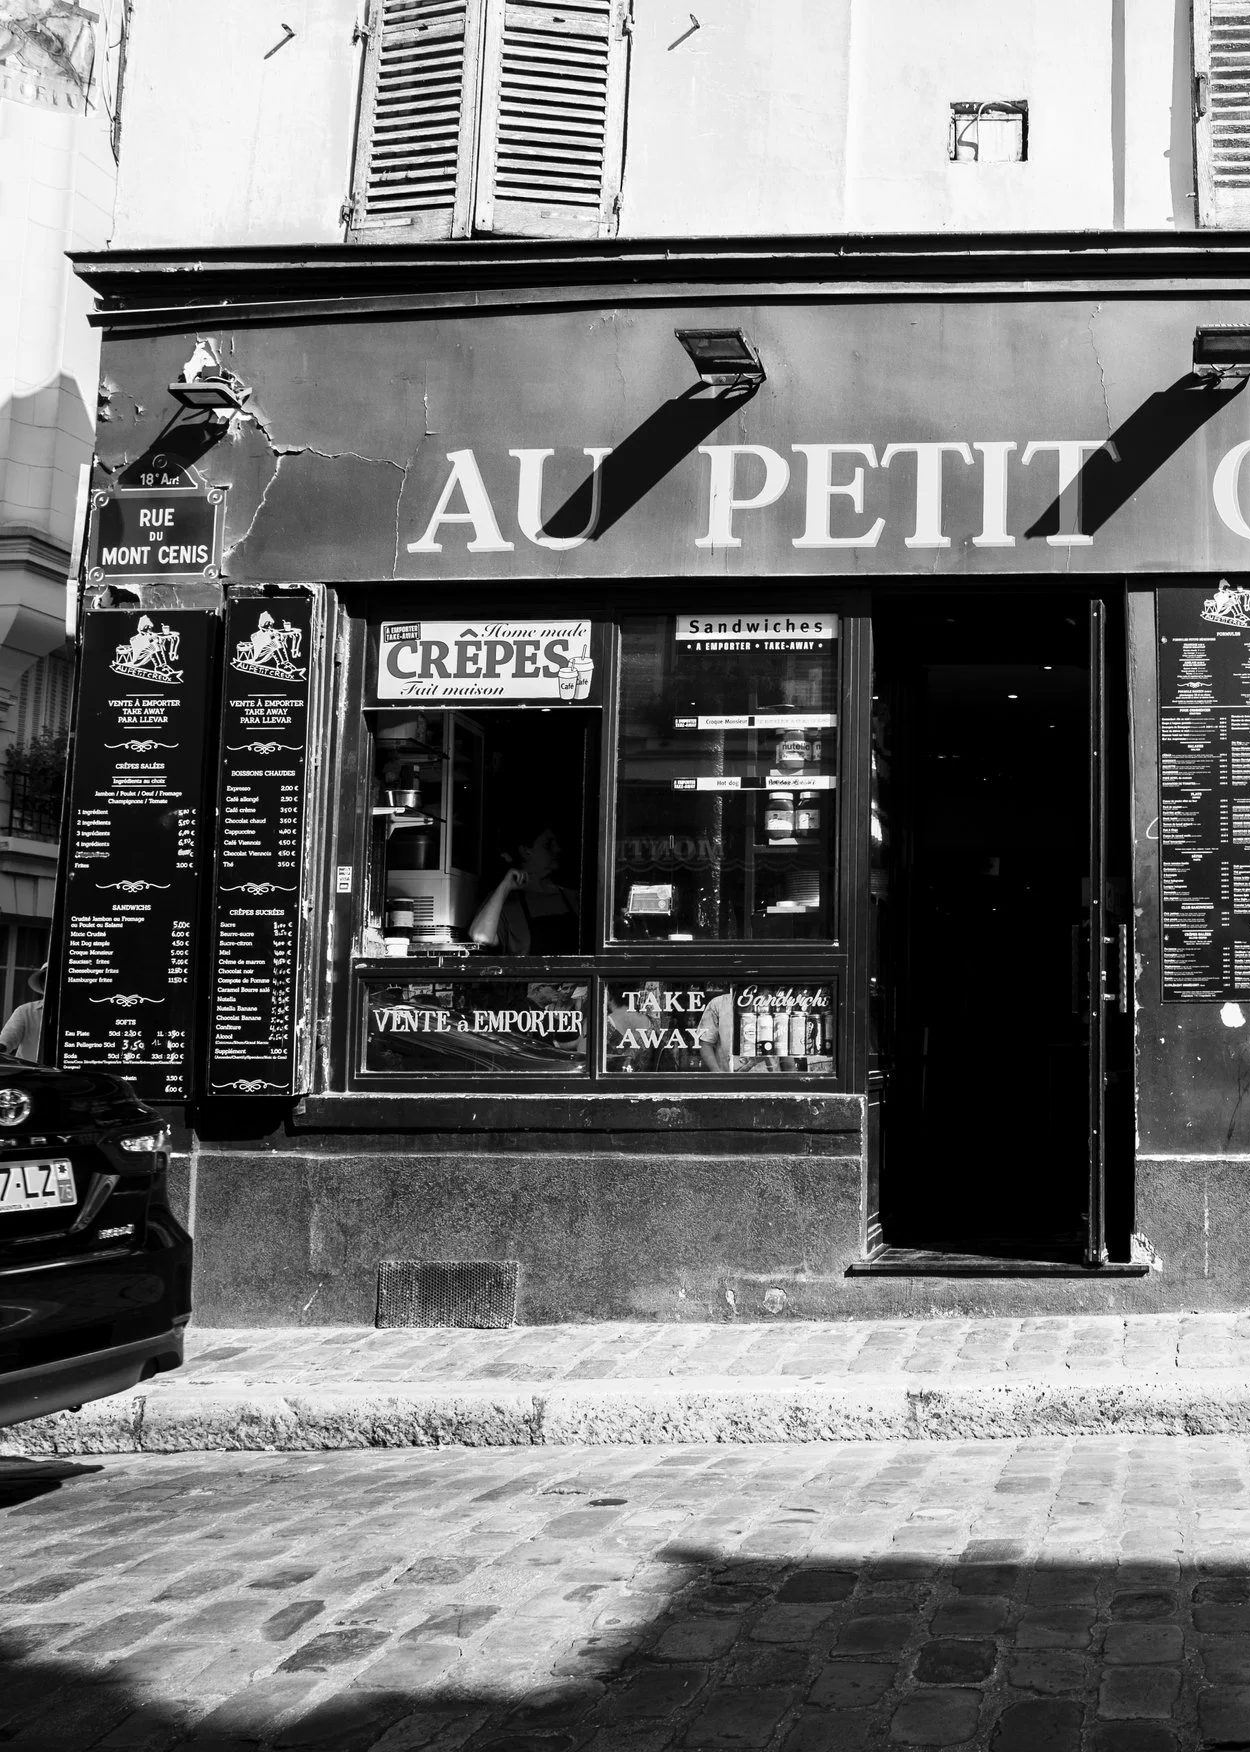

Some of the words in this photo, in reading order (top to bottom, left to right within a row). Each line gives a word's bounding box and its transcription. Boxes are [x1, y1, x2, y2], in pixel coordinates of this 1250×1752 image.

[408, 447, 613, 553] AU
[696, 441, 1116, 548] PETIT
[140, 509, 175, 527] RUE
[149, 532, 163, 541] DU
[102, 546, 151, 565] MONT
[158, 545, 208, 564] CENIS
[481, 623, 537, 638] Home
[540, 623, 587, 638] made
[689, 619, 823, 634] Sandwiches
[705, 642, 751, 650] EMPORTER
[764, 641, 814, 650] TAKE-AWAY
[386, 628, 570, 679] CRÊPES
[400, 680, 440, 696] Fait
[442, 682, 505, 696] maison
[134, 699, 140, 707] À
[256, 699, 263, 707] À
[115, 762, 140, 770] CRÊPES
[140, 761, 165, 770] SALÉES
[728, 780, 739, 788] dog
[229, 908, 254, 916] CRÊPES
[255, 908, 285, 916] SUCRÉES
[622, 991, 707, 1012] TAKE
[373, 1010, 451, 1033] VENTE
[457, 1015, 470, 1032] à
[473, 1010, 583, 1037] EMPORTER
[616, 1028, 709, 1049] AWAY
